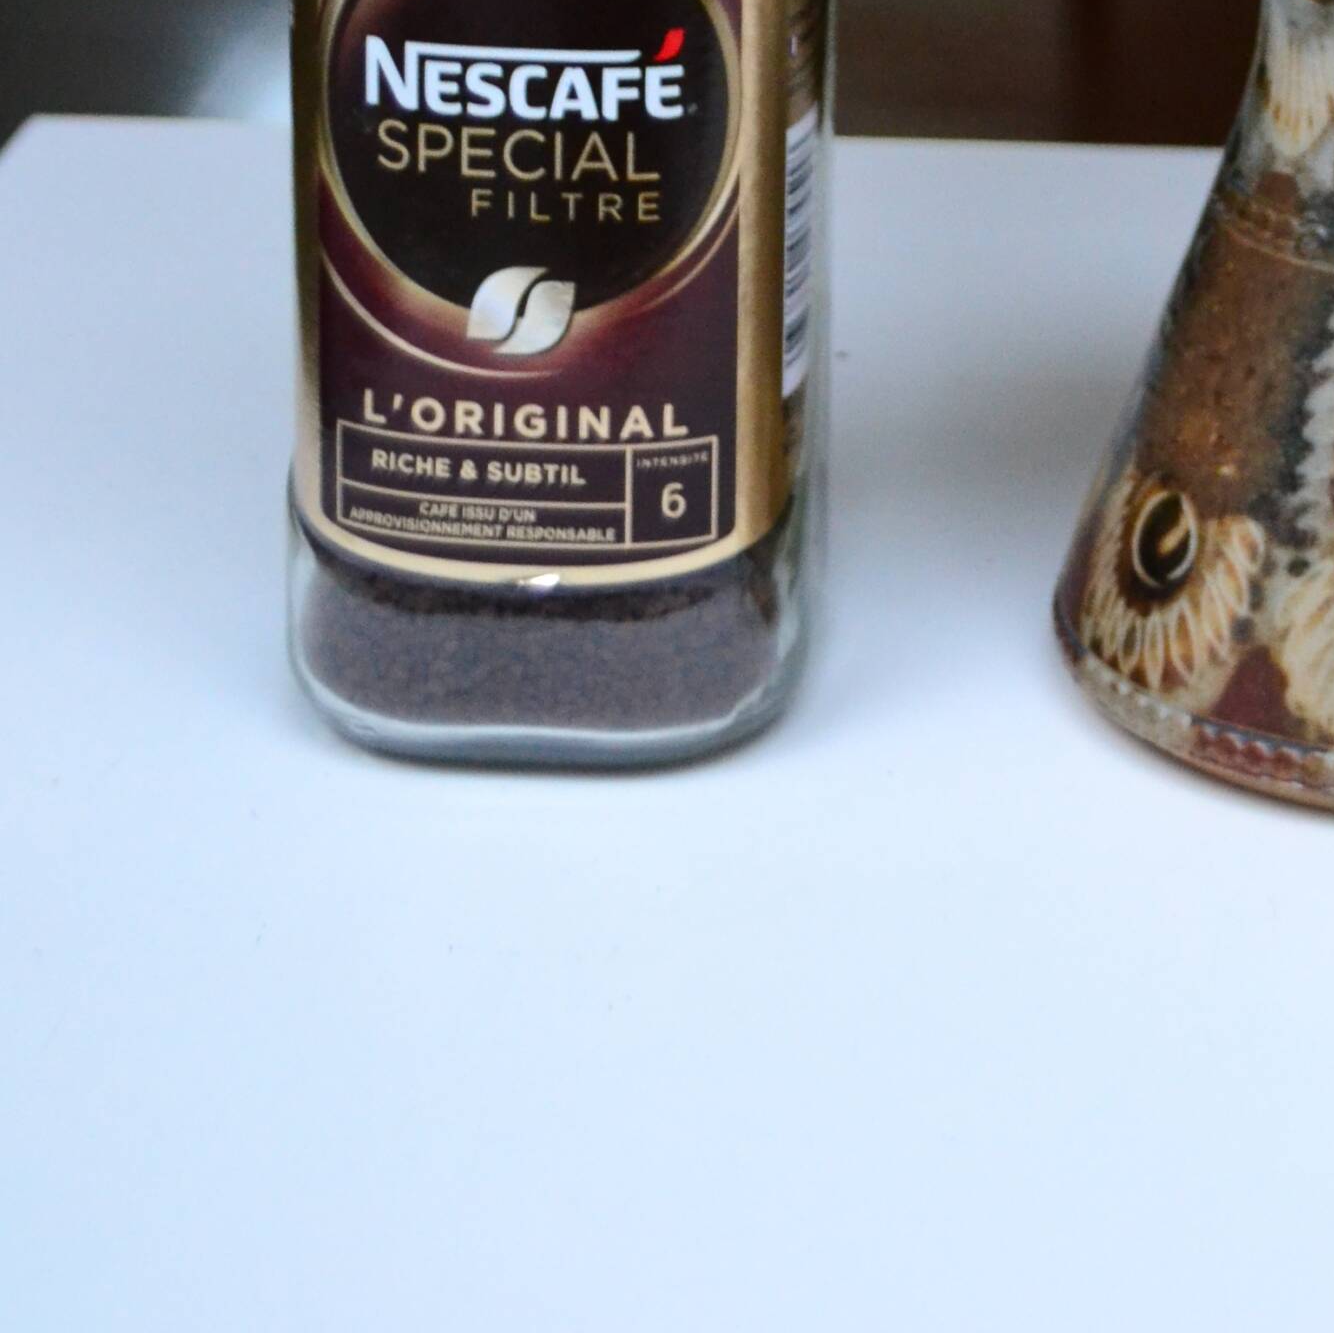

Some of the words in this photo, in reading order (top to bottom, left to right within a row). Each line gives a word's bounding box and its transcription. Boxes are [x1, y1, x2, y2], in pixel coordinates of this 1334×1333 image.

[365, 28, 685, 121] NESCAFÉ
[377, 119, 661, 181] SPECIAL
[470, 189, 661, 221] FILTRE
[363, 388, 689, 440] L'ORIGINAL
[371, 448, 451, 478] RICHE
[459, 459, 478, 481] &
[486, 460, 587, 486] SUBTIL
[462, 505, 495, 521] ISSU
[661, 481, 687, 519] 6
